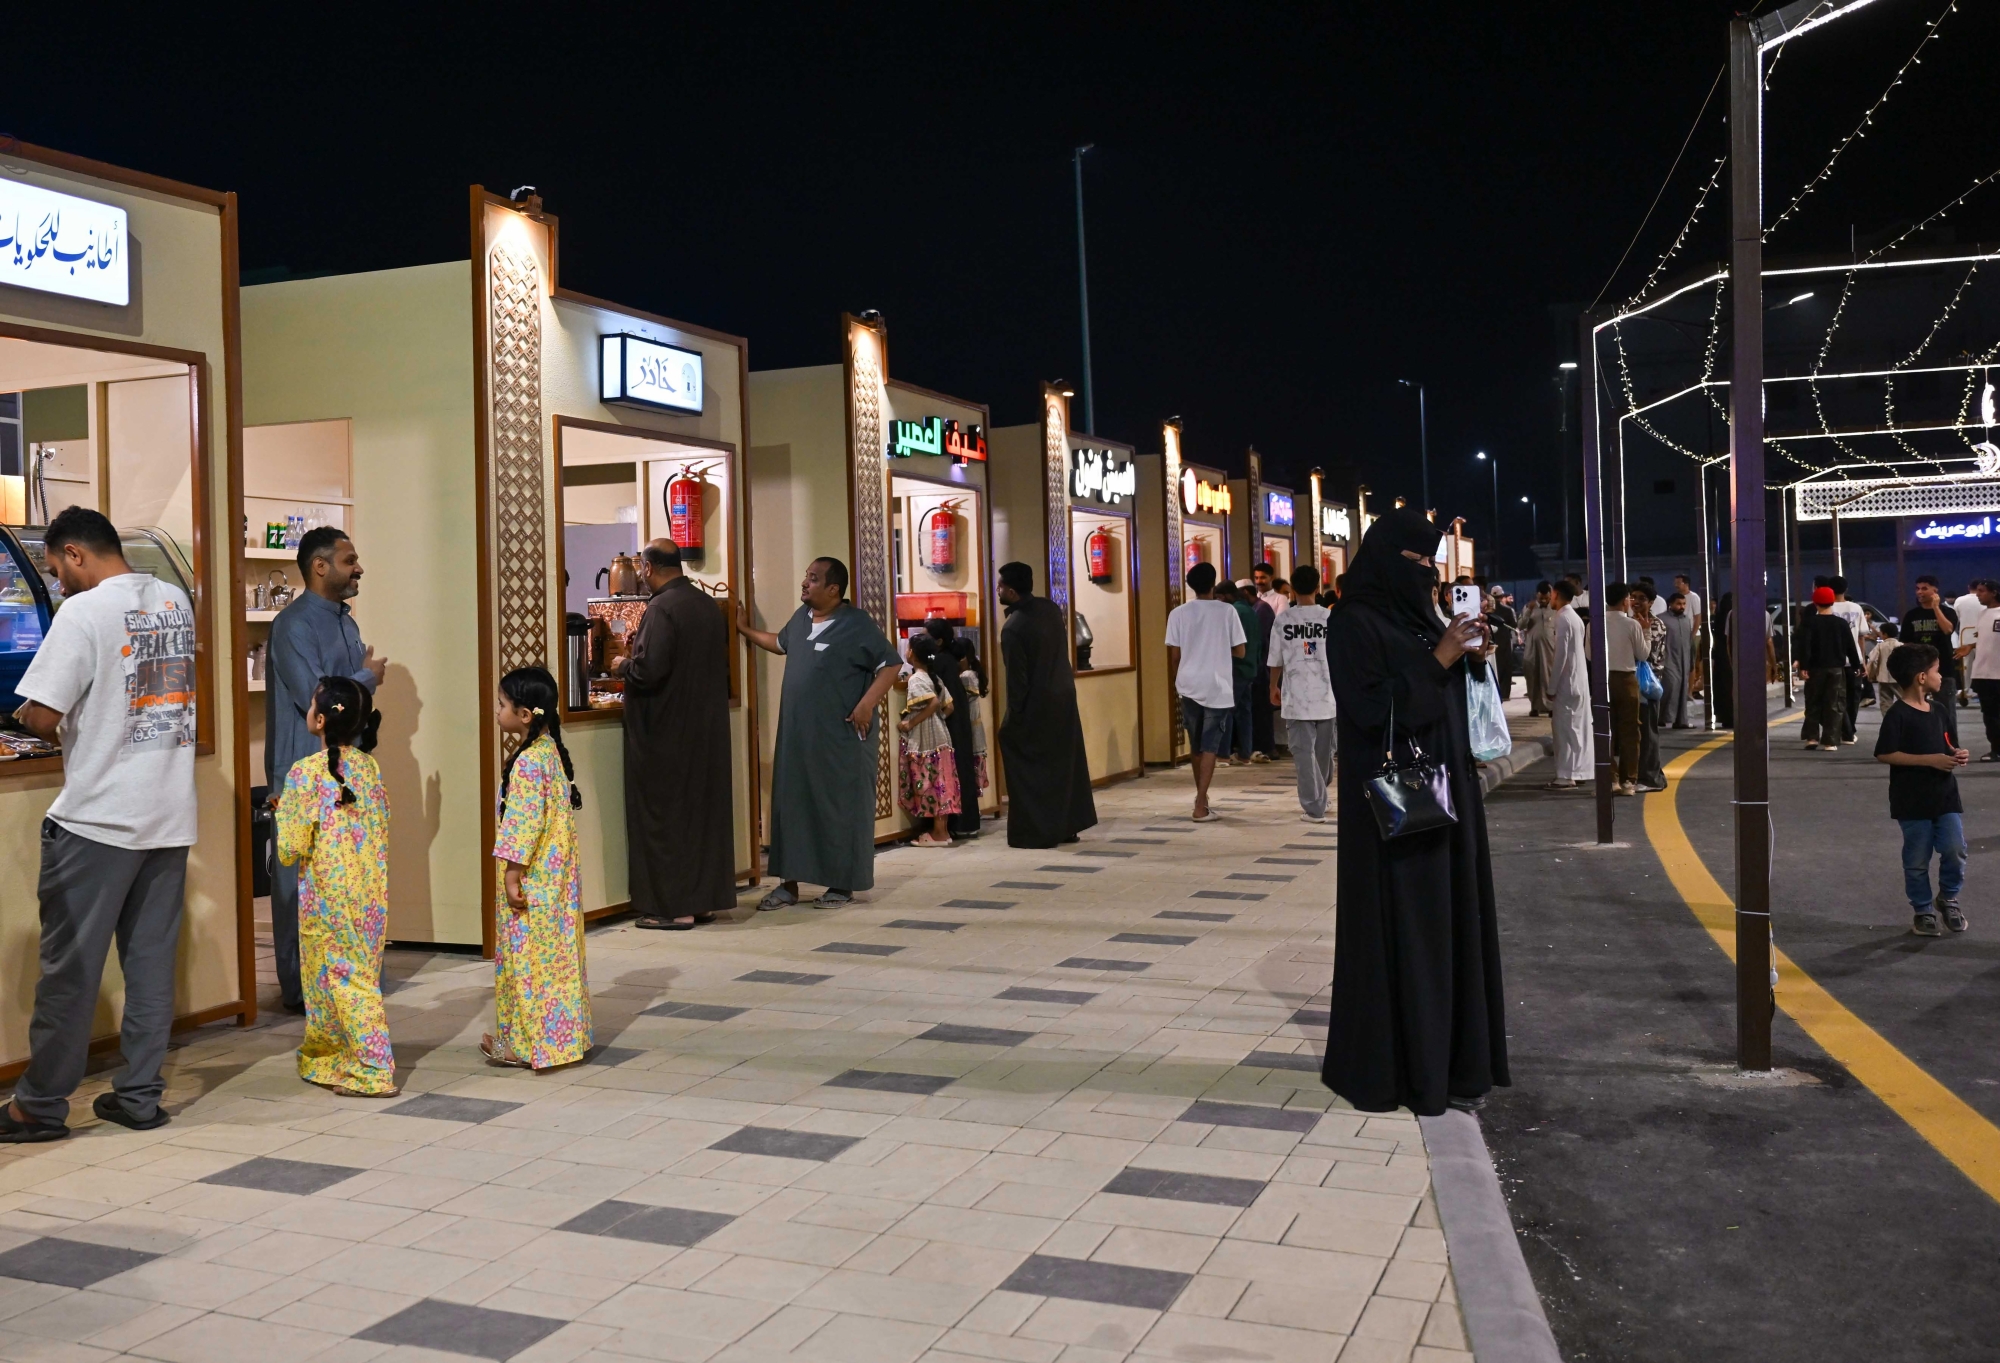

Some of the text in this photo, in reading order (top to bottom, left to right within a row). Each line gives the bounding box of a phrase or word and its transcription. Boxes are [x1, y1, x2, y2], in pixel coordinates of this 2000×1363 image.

[895, 416, 988, 465] طيف العصير
[126, 612, 159, 632] SHOW
